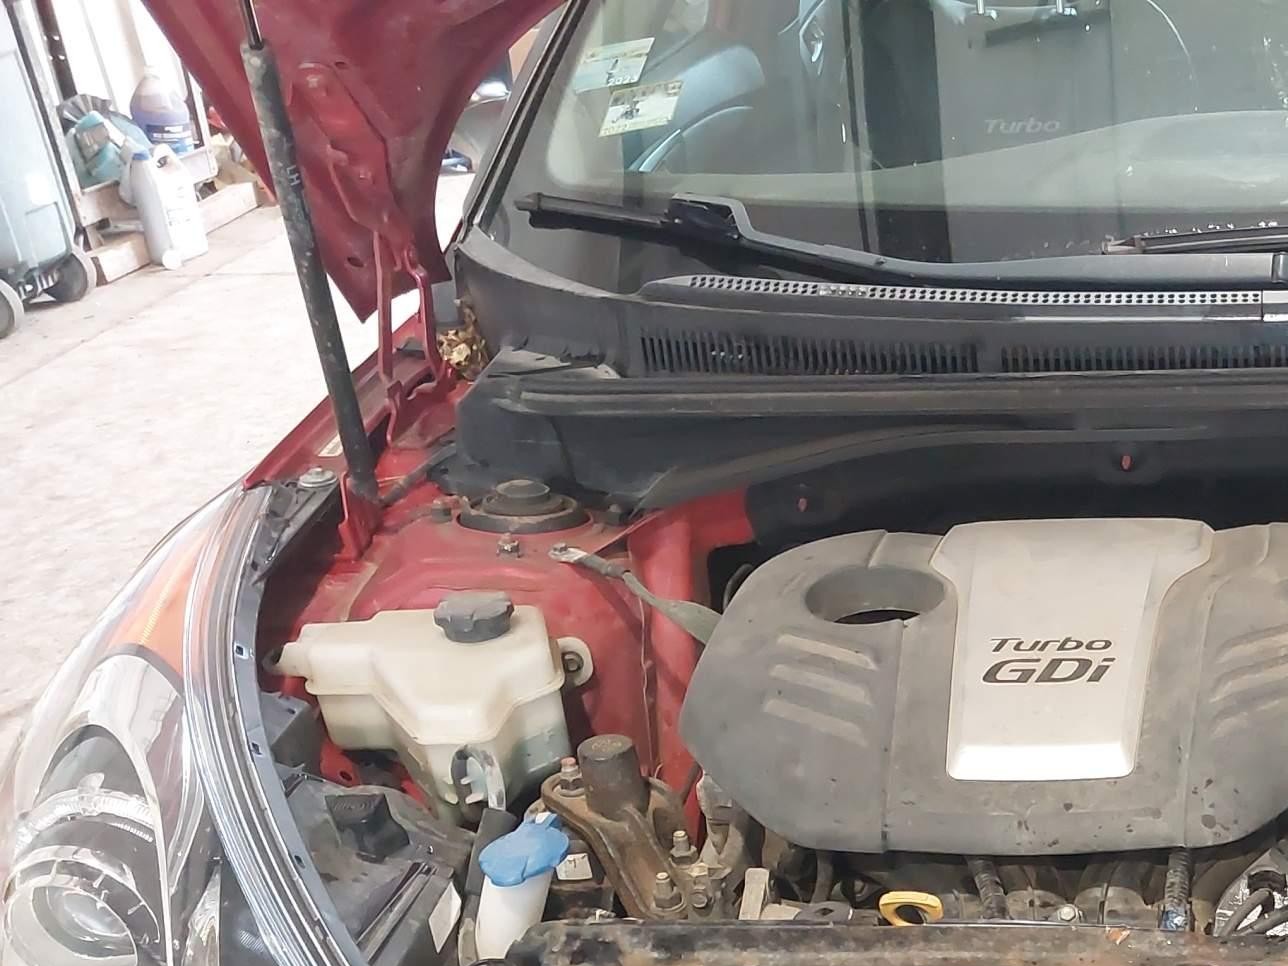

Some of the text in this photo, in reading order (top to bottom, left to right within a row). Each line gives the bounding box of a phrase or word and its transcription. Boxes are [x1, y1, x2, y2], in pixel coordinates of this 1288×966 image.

[984, 117, 1061, 134] Turbo
[991, 636, 1113, 653] Turbo
[982, 657, 1116, 684] GDi
